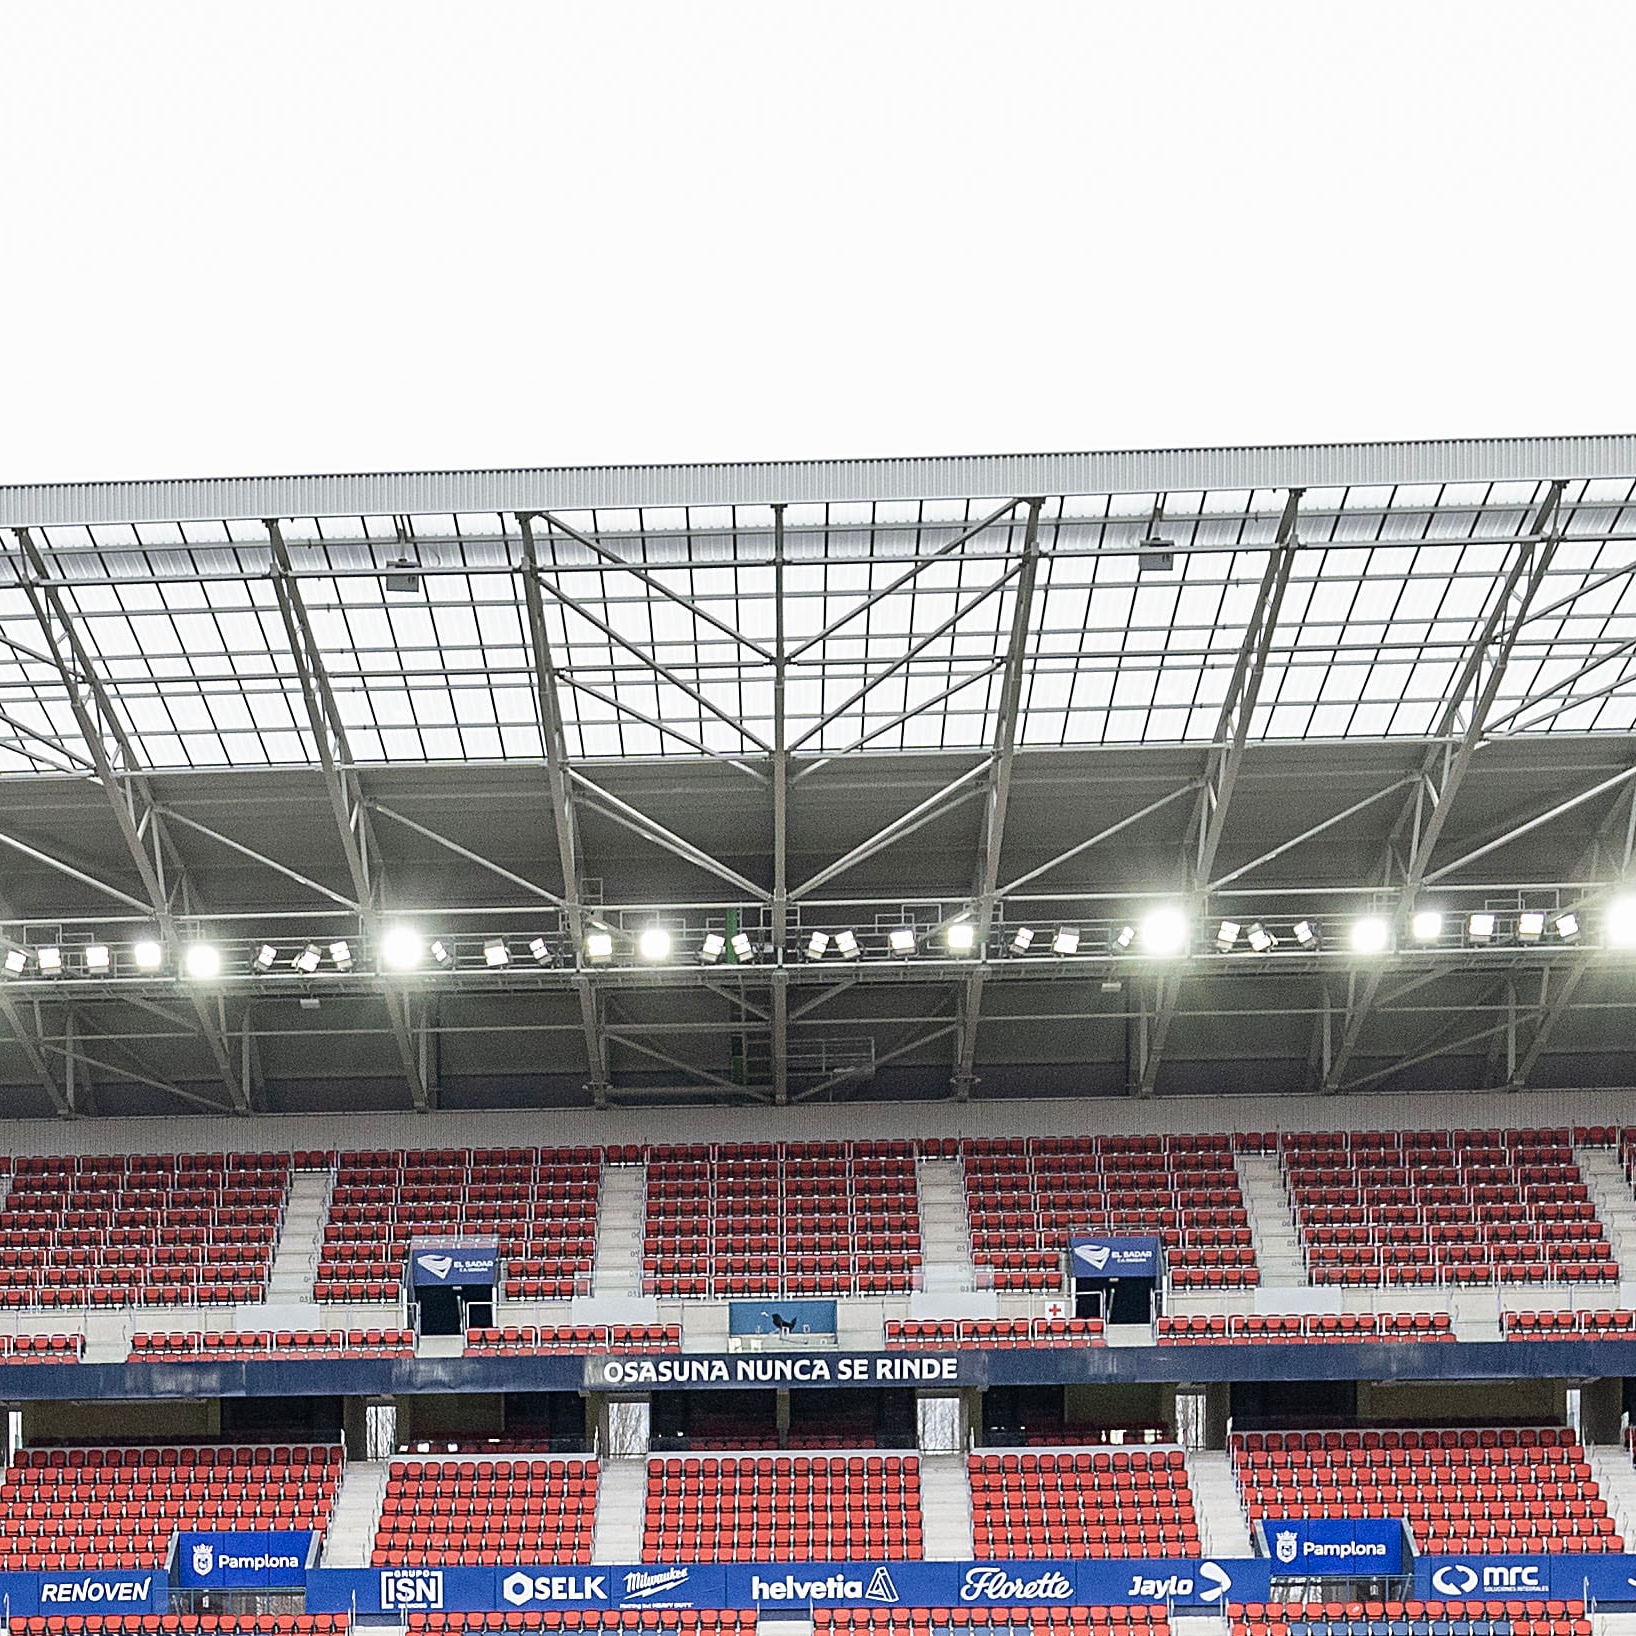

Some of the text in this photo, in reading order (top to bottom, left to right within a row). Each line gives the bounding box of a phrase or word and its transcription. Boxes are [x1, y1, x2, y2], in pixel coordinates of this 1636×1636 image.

[603, 1358, 958, 1382] OSASUNA NUNCA SE RINDE
[1303, 1541, 1387, 1559] Pamplona
[218, 1554, 299, 1573] Pamplona
[394, 1570, 431, 1578] GRUPO
[1483, 1565, 1539, 1585] mrc
[41, 1577, 152, 1603] RENOVEN
[387, 1578, 437, 1602] ISN
[622, 1567, 691, 1590] Milwaukee
[751, 1574, 863, 1600] helvetia
[960, 1567, 1074, 1601] Florette
[1128, 1575, 1194, 1600] Jaylo
